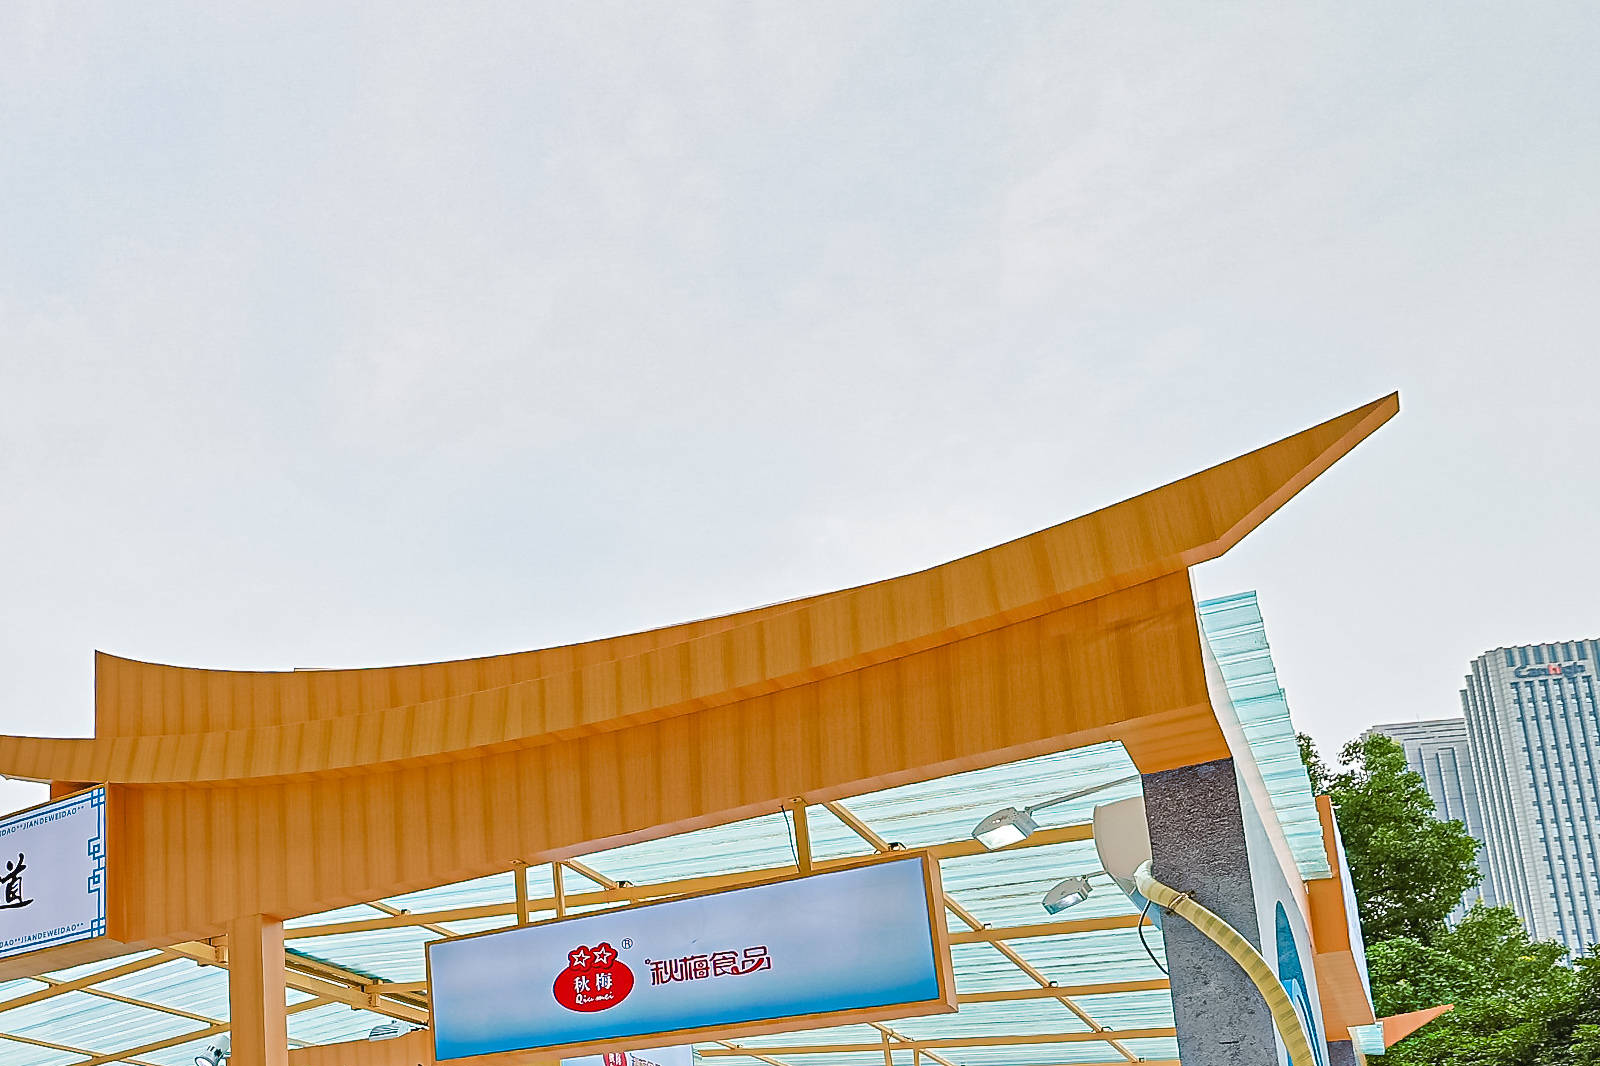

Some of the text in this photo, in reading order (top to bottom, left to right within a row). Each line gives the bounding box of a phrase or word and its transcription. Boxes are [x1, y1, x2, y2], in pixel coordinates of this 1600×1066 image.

[650, 945, 772, 986] 秋梅食品
[573, 972, 613, 994] 秋梅
